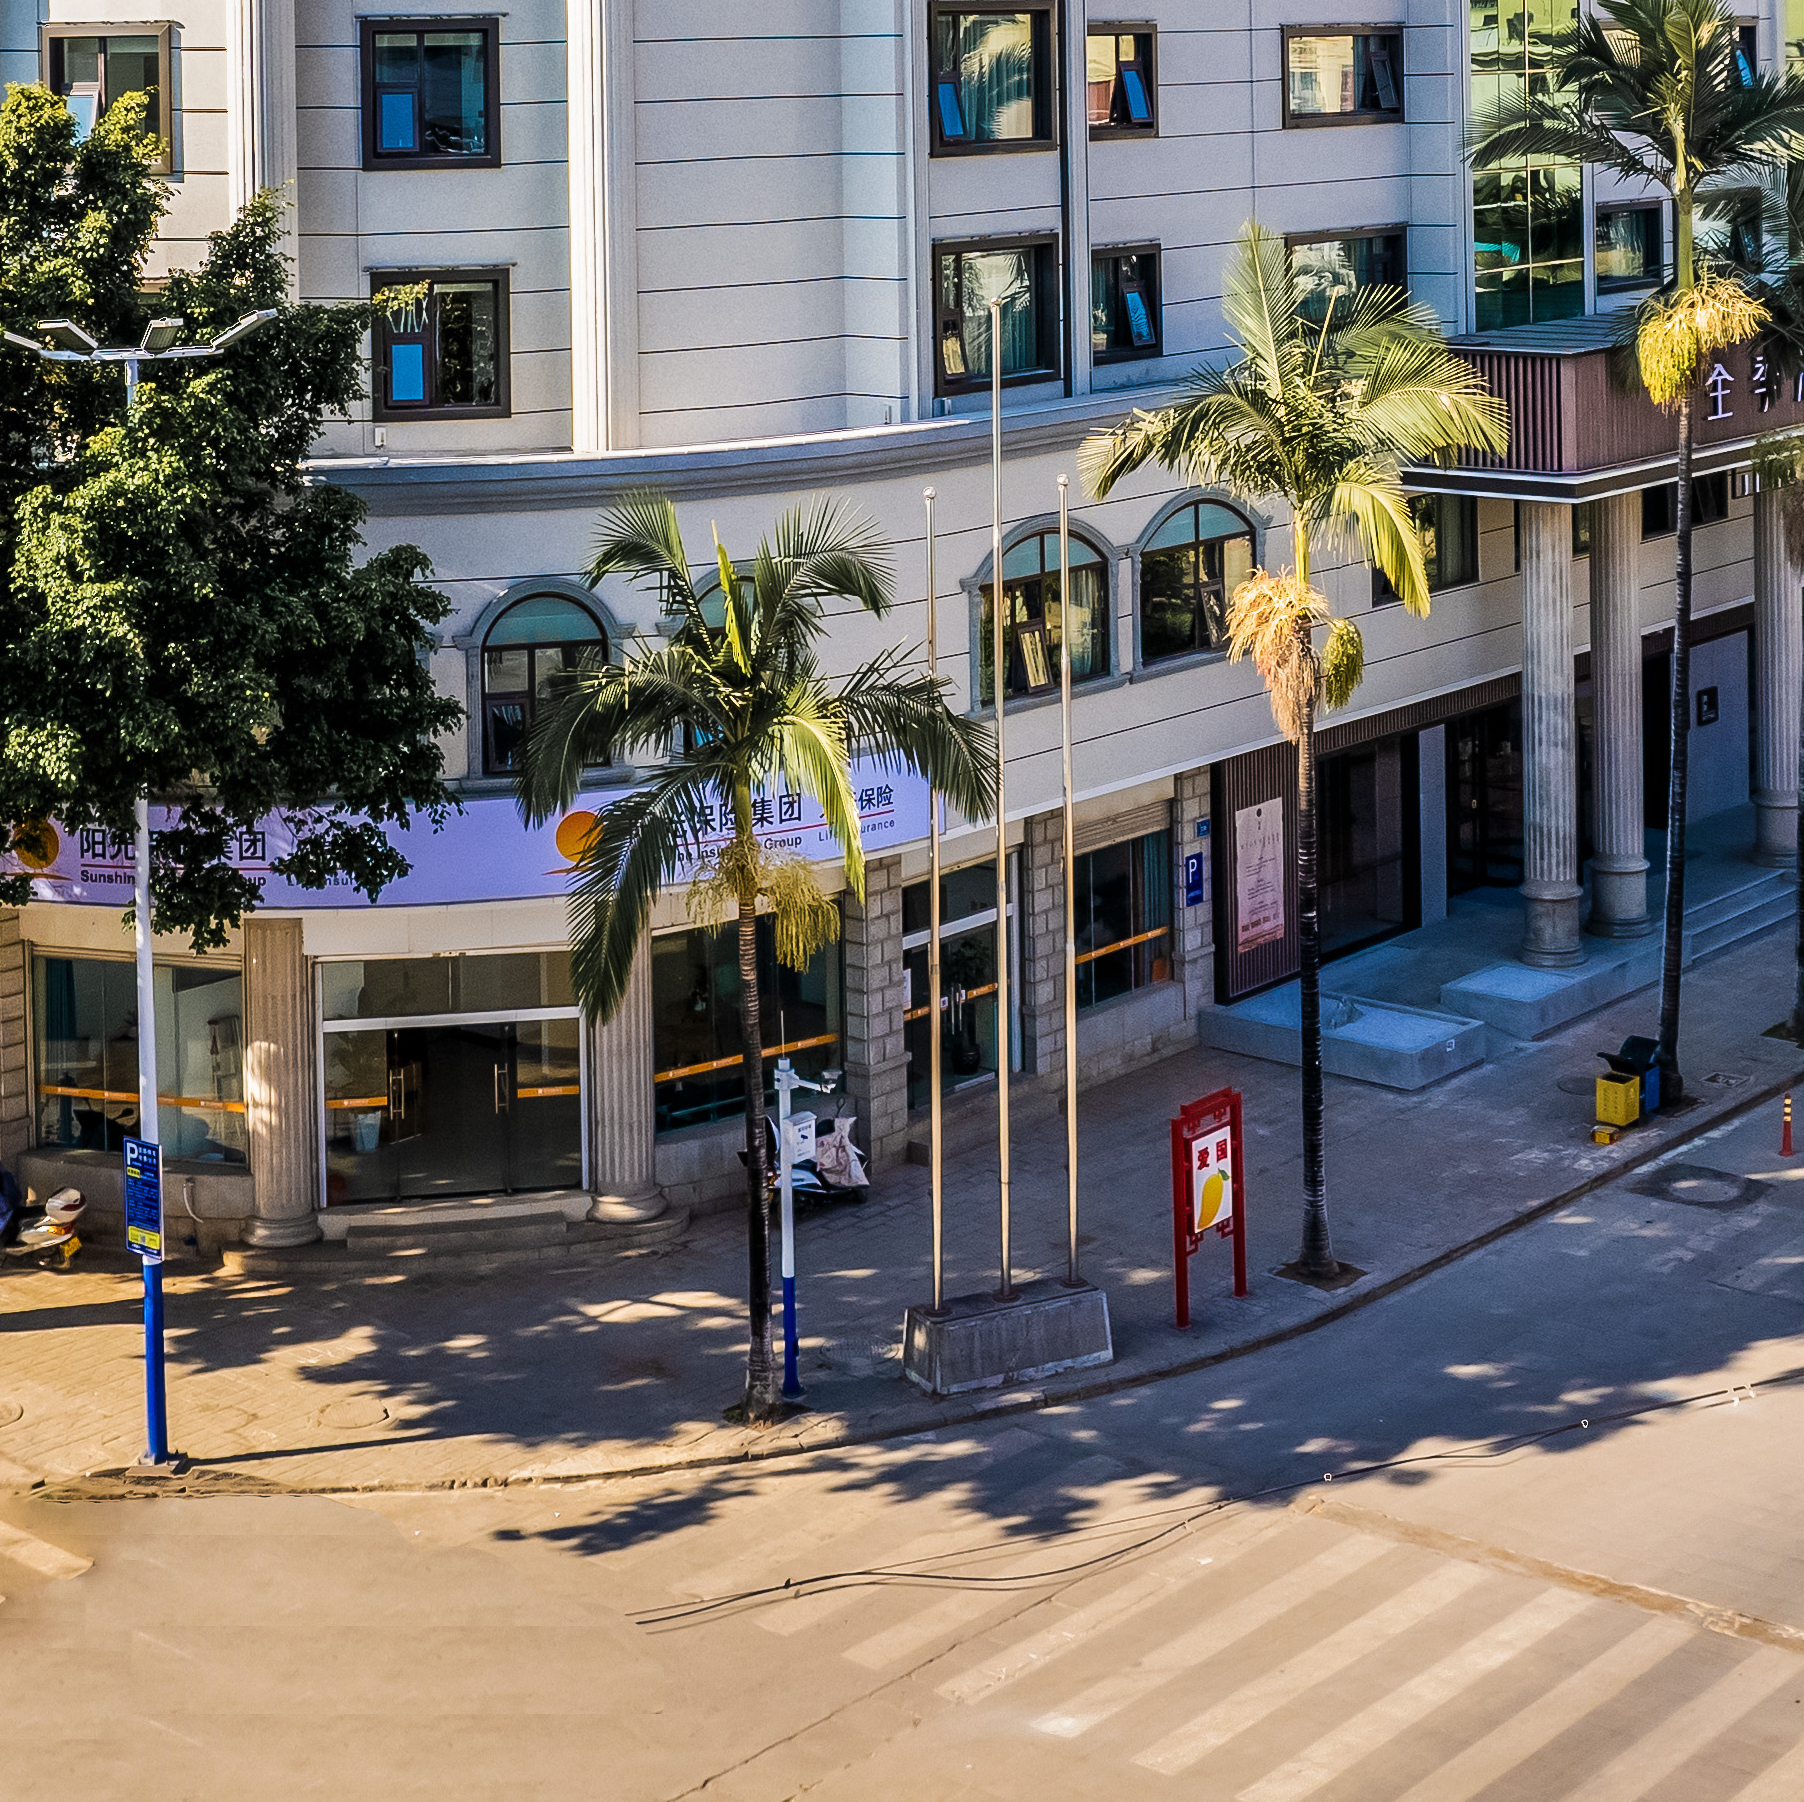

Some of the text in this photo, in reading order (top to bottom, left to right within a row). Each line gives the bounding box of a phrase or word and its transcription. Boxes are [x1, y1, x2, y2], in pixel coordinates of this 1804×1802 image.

[763, 835, 802, 850] Group
[80, 870, 136, 885] Sunshin
[1188, 858, 1197, 884] P
[126, 1142, 139, 1166] P
[1197, 1138, 1228, 1171] 爱国
